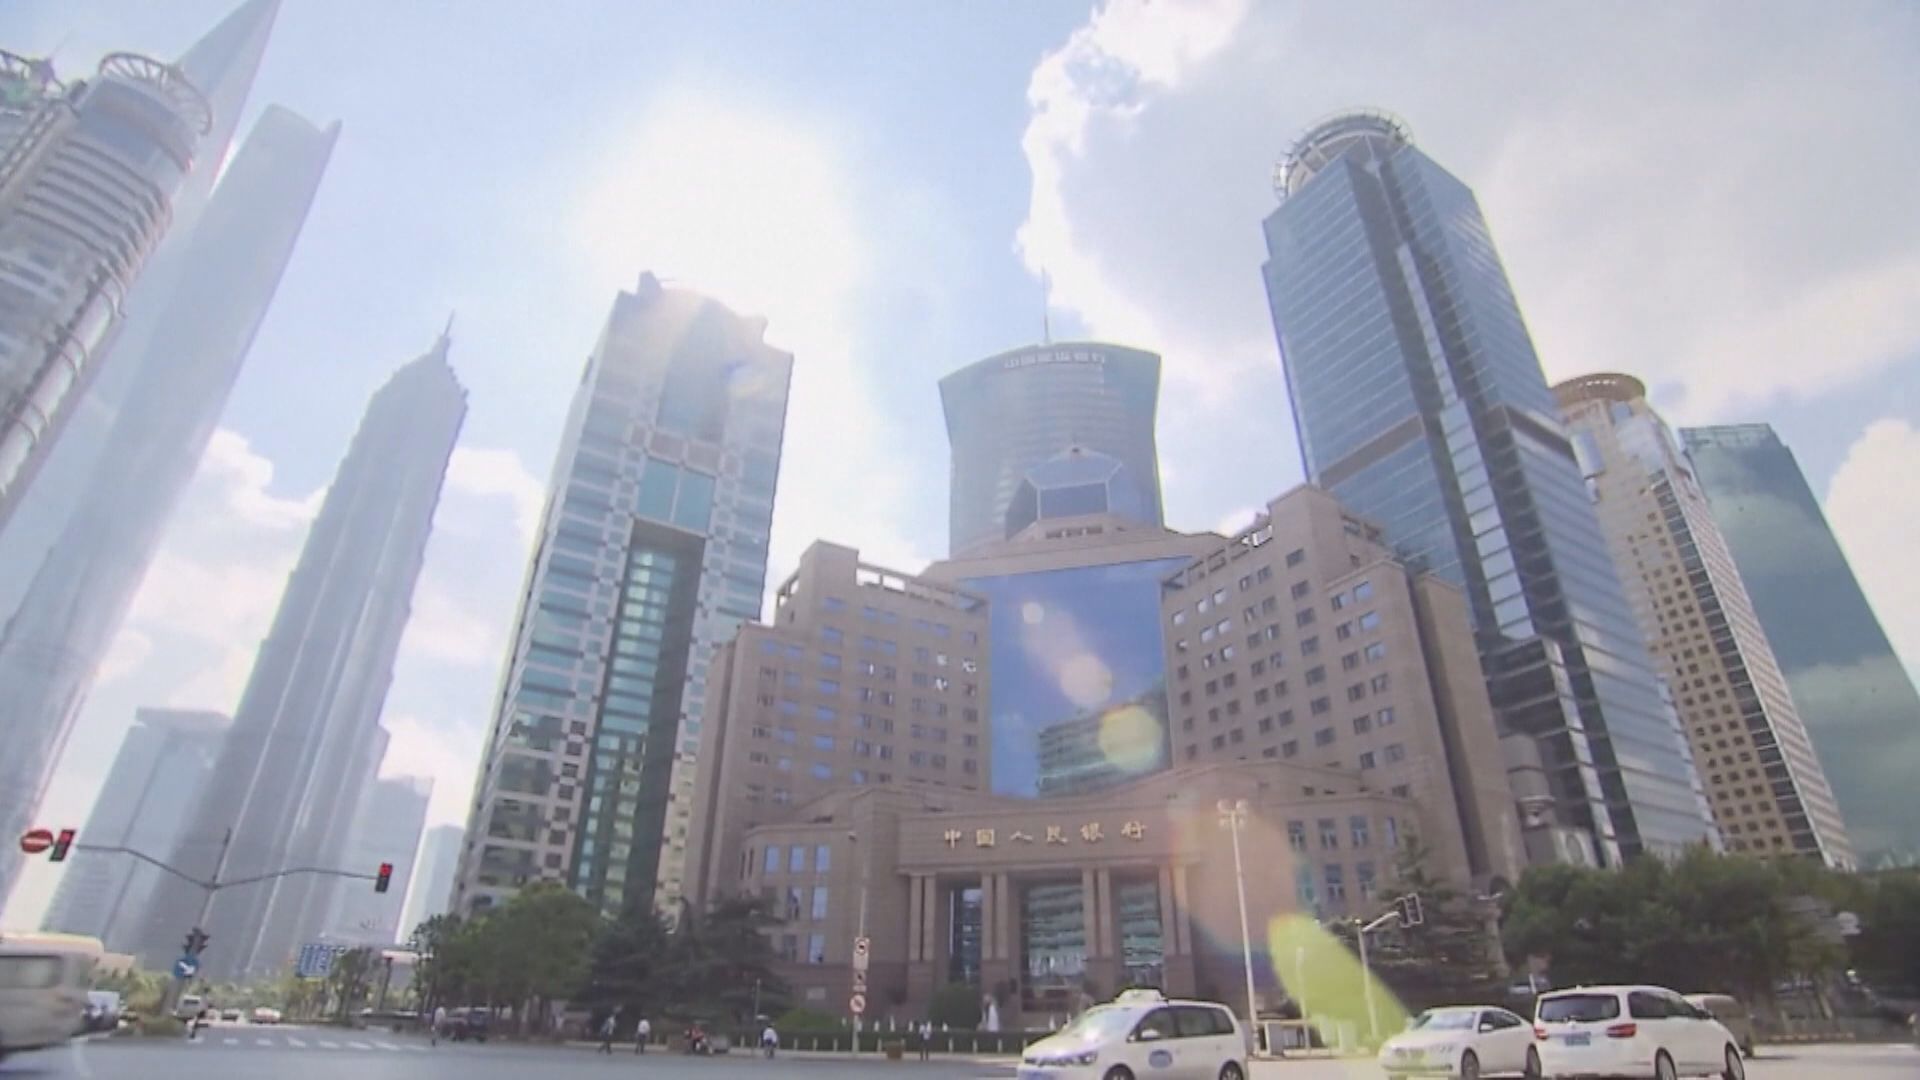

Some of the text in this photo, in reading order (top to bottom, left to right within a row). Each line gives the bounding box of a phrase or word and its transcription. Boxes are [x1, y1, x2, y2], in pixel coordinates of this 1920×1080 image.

[943, 819, 1147, 848] 中国人民银行
